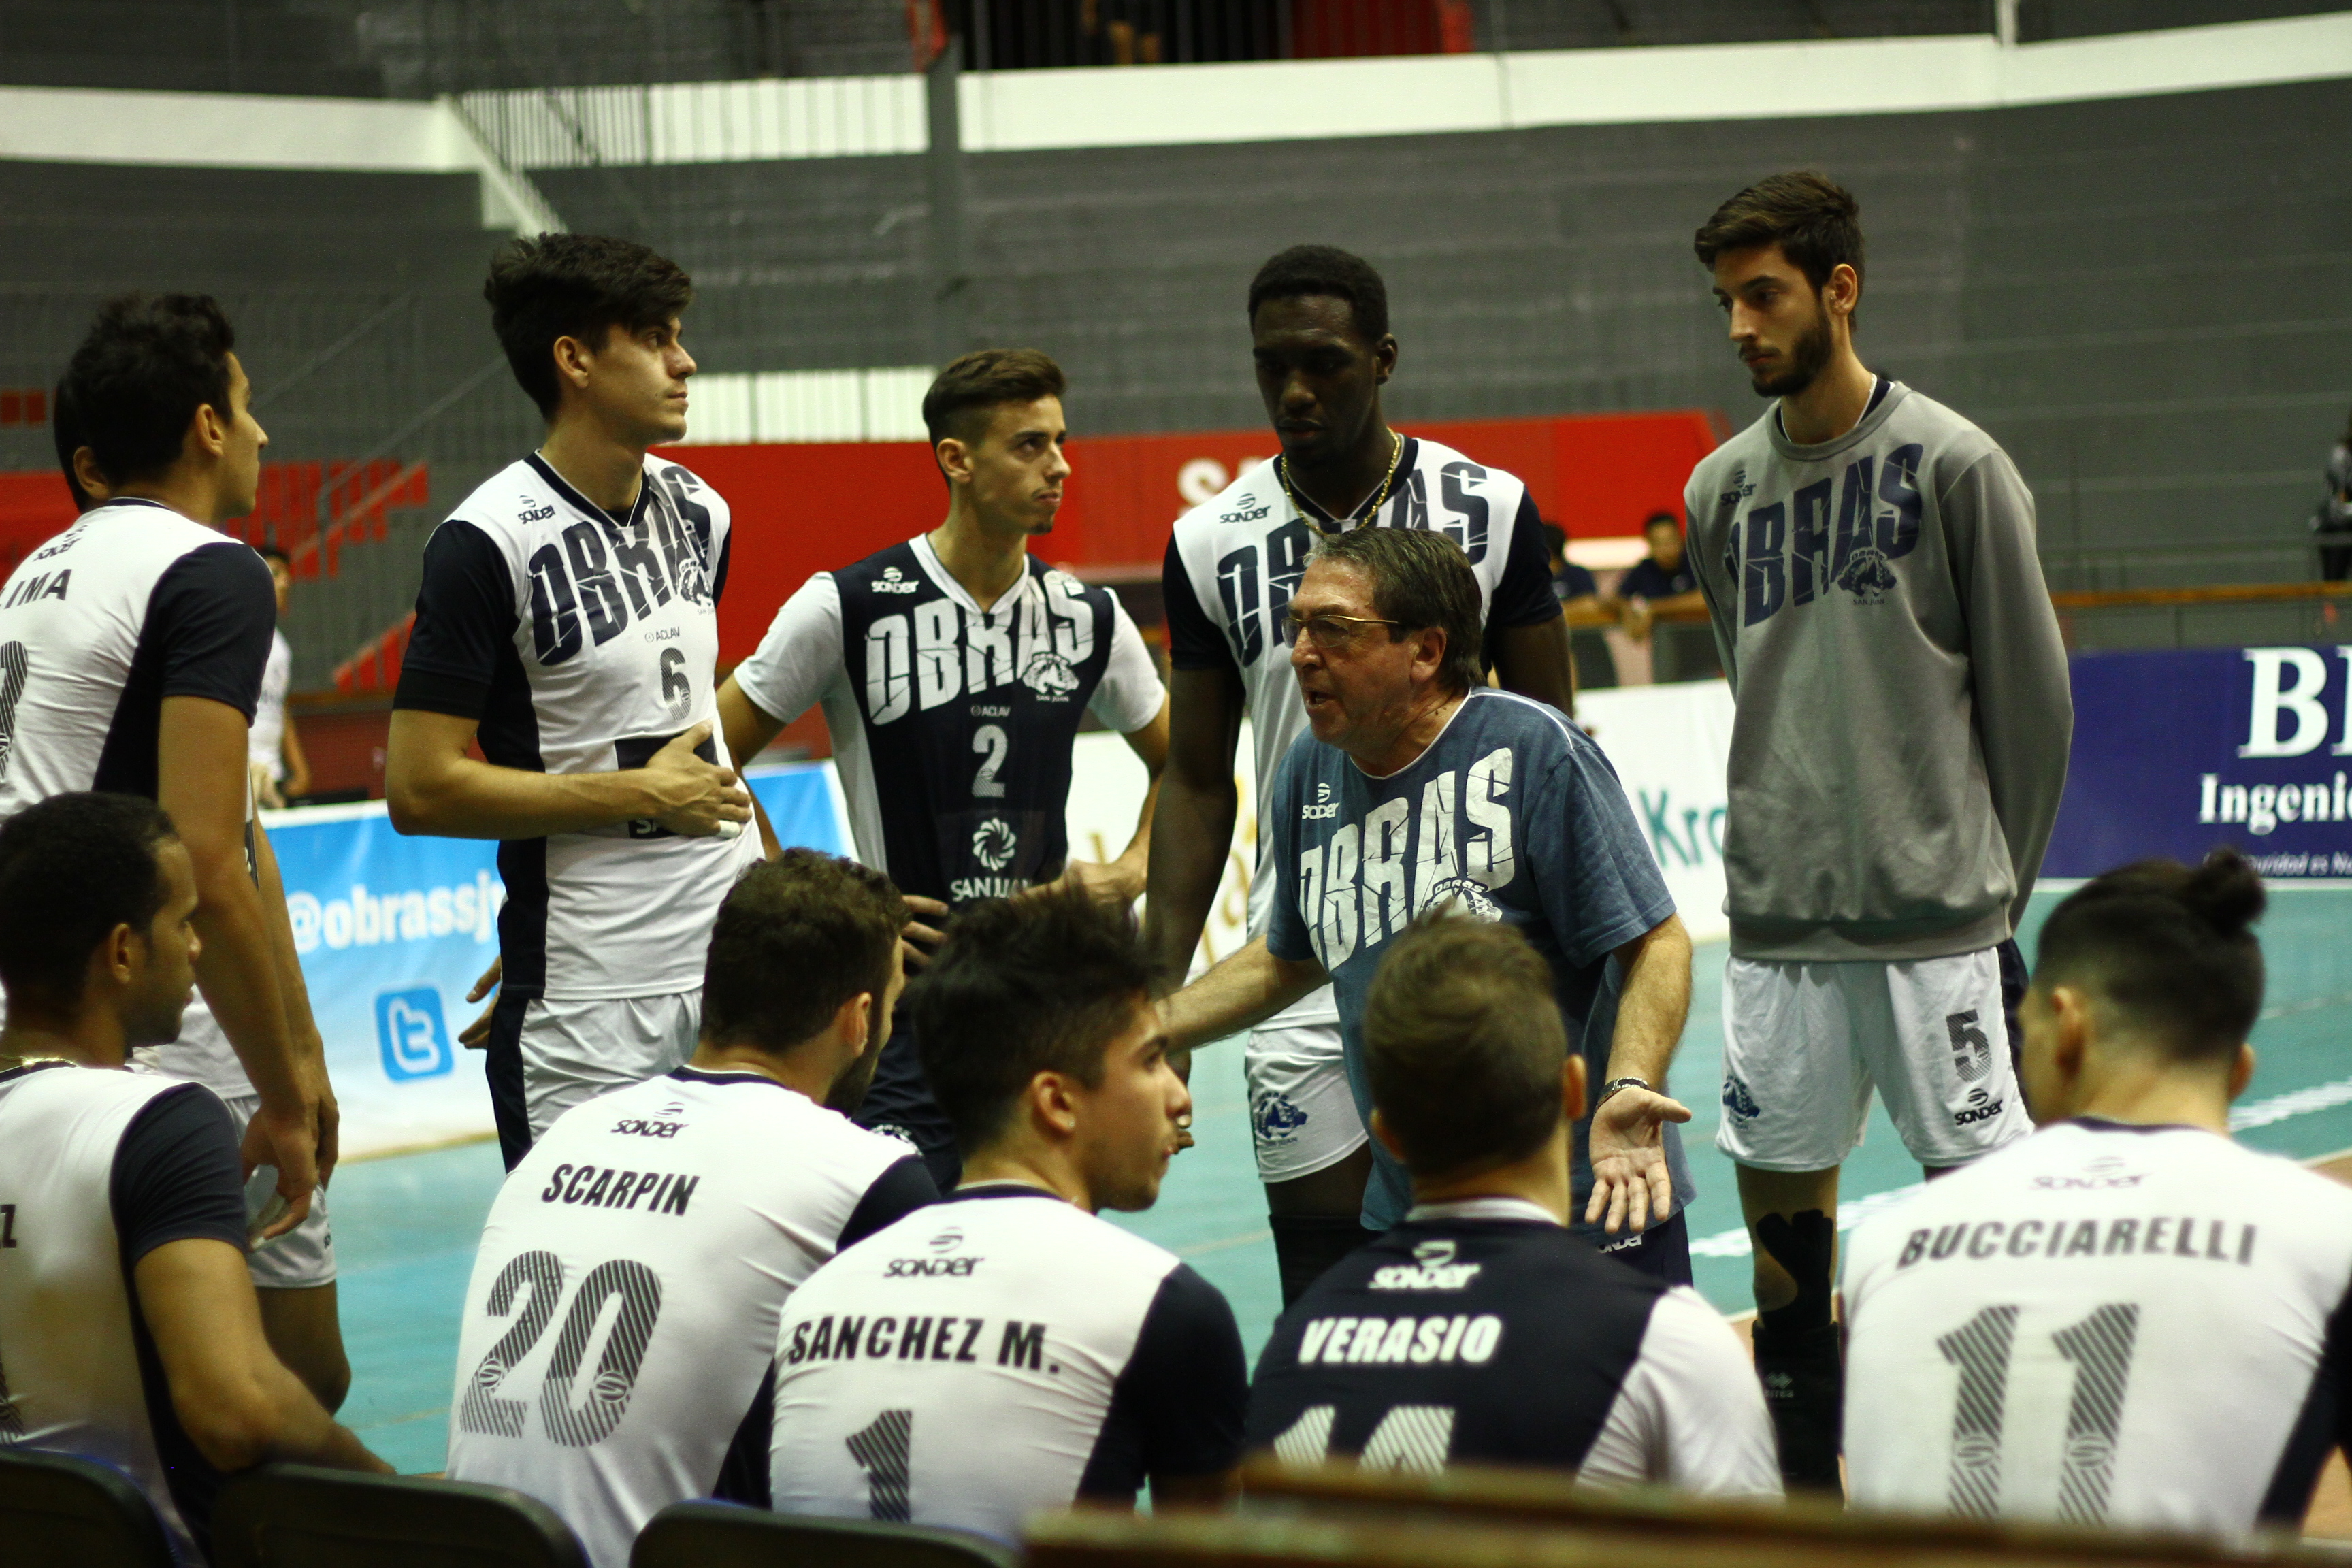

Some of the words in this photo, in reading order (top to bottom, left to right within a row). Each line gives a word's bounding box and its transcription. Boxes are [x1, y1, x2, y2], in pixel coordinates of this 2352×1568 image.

[0, 568, 72, 609] IMA
[1217, 461, 1489, 667] OBS
[655, 626, 681, 642] ACLAV
[864, 570, 1094, 725] OBRAS
[660, 647, 692, 721] 6
[981, 705, 1011, 717] ACLAV
[2237, 646, 2352, 759] B
[972, 723, 1008, 798] 2
[951, 876, 992, 902] SAN
[994, 877, 1028, 899] JU
[1299, 747, 1516, 974] OBRAS
[1946, 1009, 1993, 1083] 5
[542, 1163, 700, 1217] SCARPIN
[1896, 1217, 2257, 1270] BUCCIARELLI
[459, 1250, 663, 1448] 20
[787, 1315, 985, 1365] SANCHEZ
[997, 1320, 1060, 1374] M.
[1298, 1313, 1503, 1365] VERASIO
[1936, 1303, 2140, 1527] 11
[845, 1409, 913, 1524] 1
